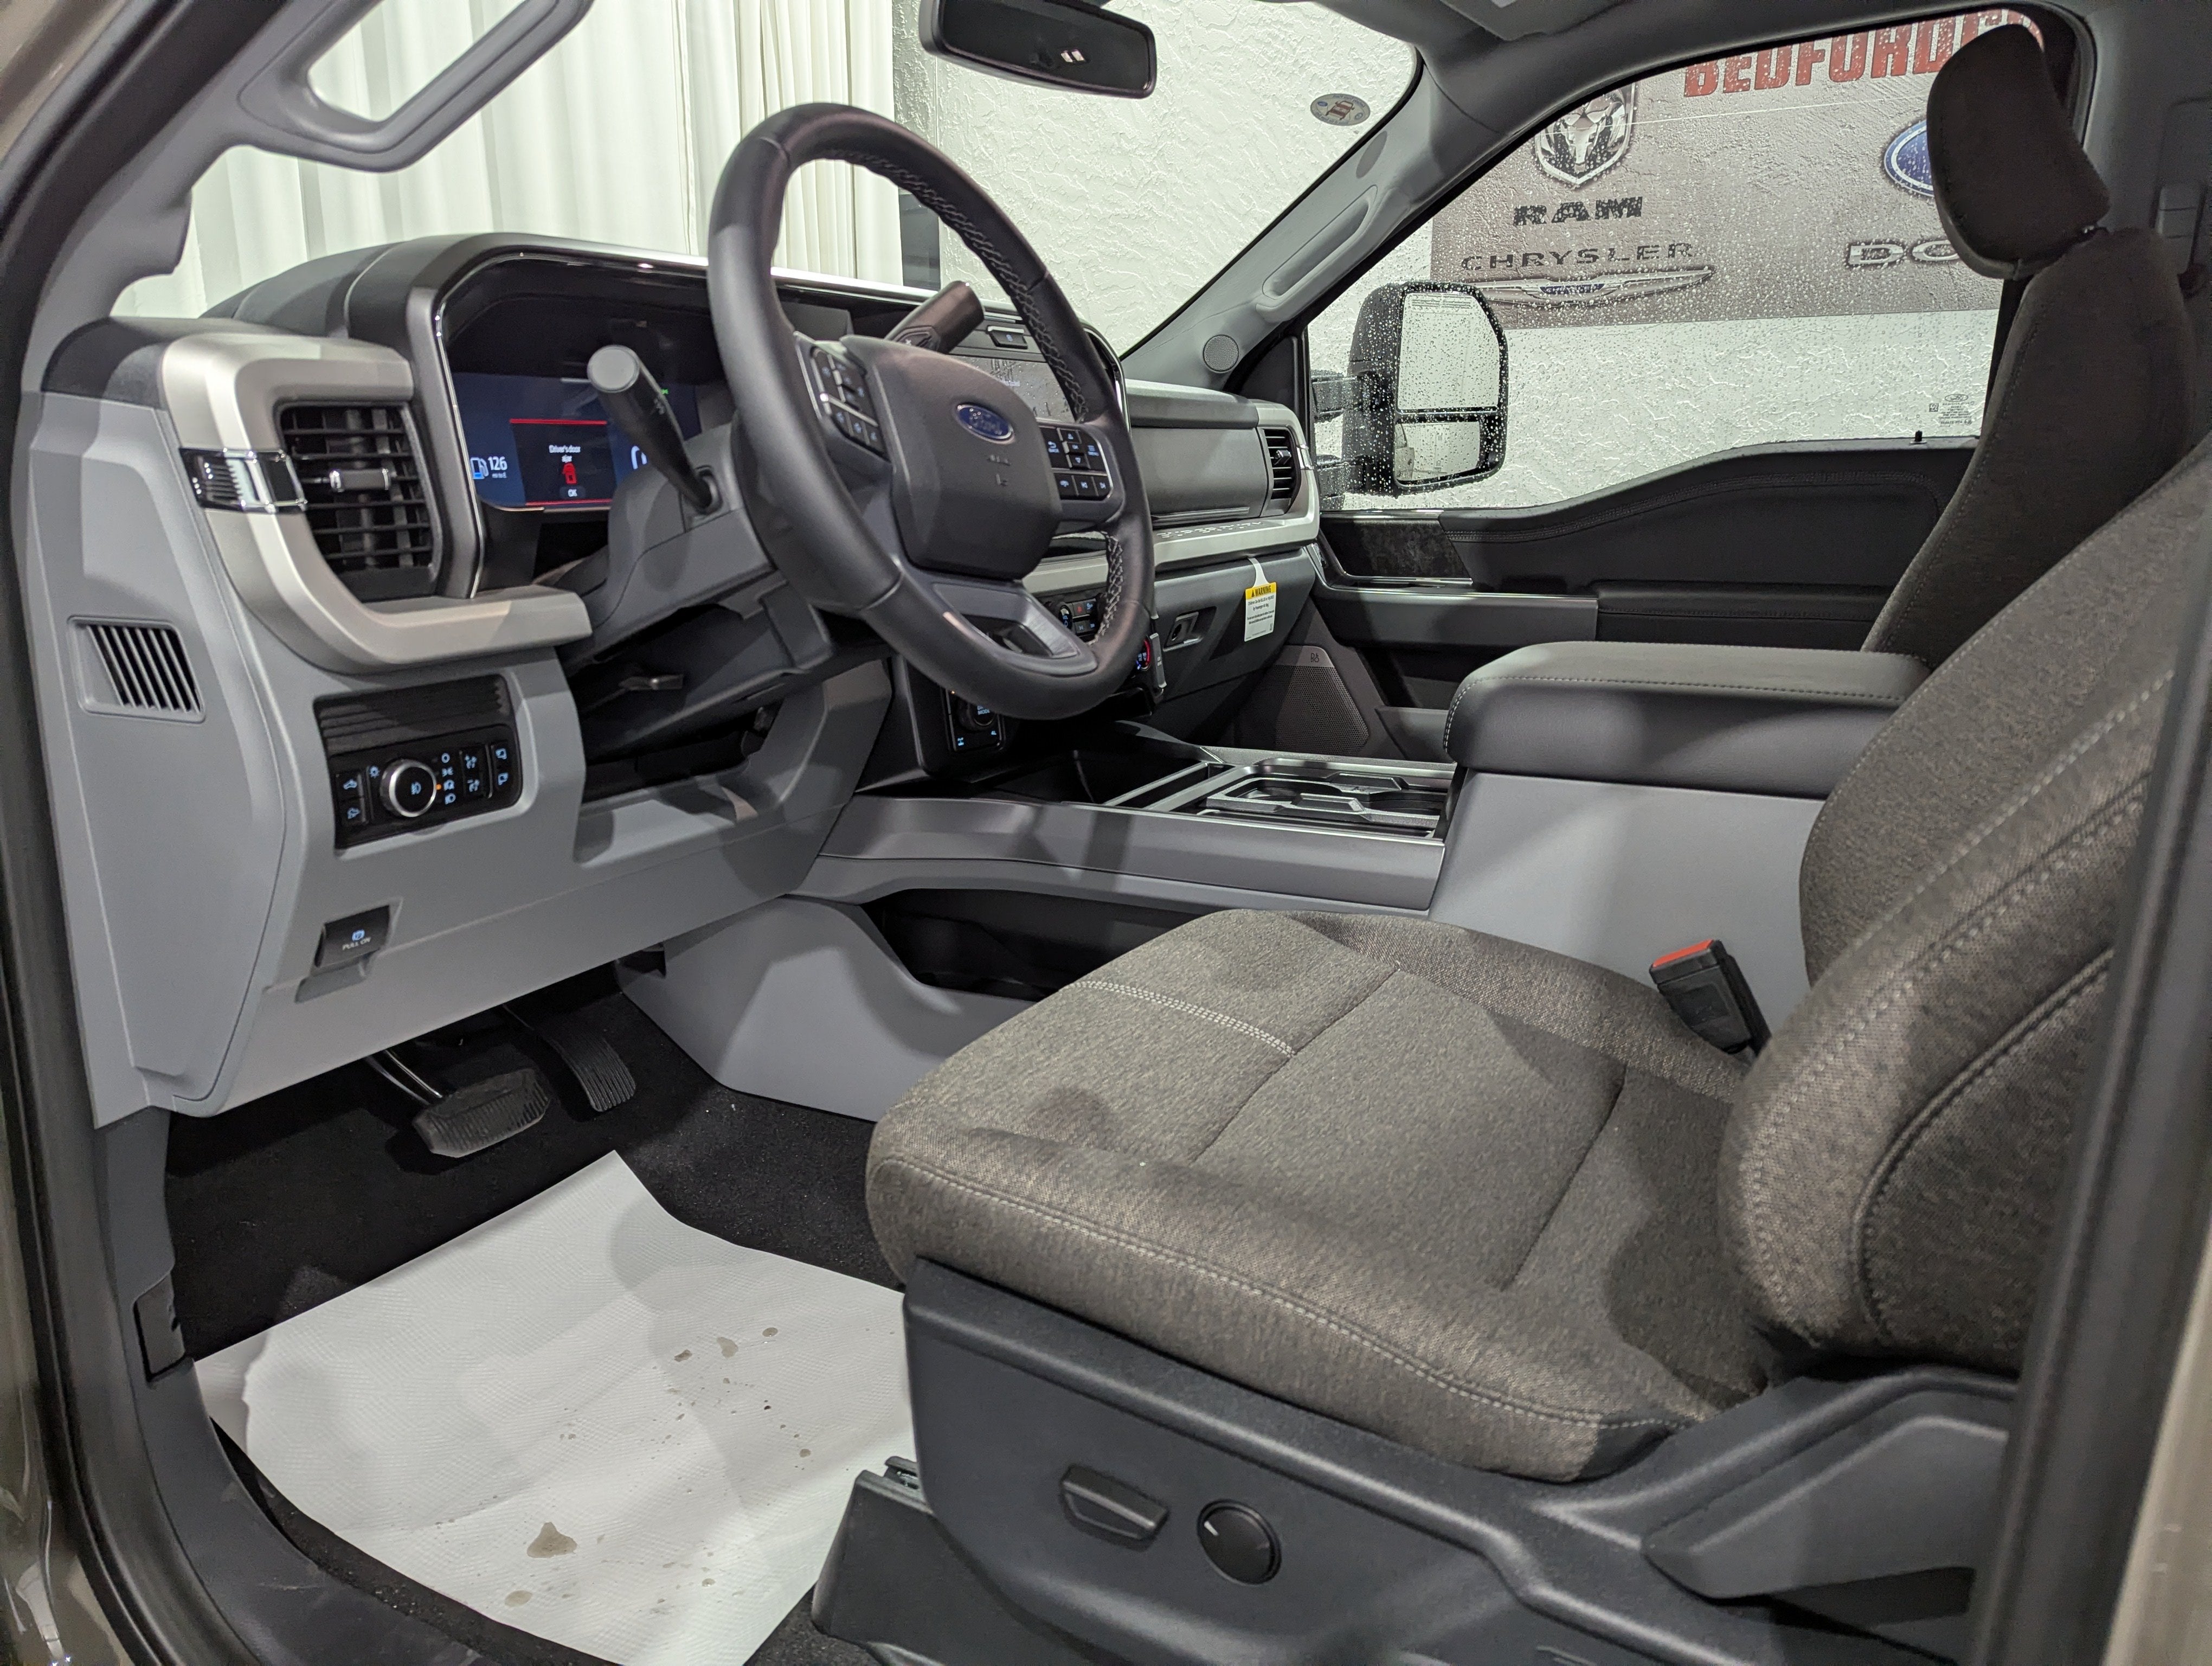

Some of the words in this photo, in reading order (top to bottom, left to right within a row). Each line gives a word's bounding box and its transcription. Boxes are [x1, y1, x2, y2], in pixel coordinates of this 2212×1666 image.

[1513, 196, 1643, 226] RAM
[1461, 242, 1693, 270] CHRYSLER
[488, 456, 507, 471] 126
[568, 489, 578, 497] OK
[1255, 585, 1271, 597] WARNING
